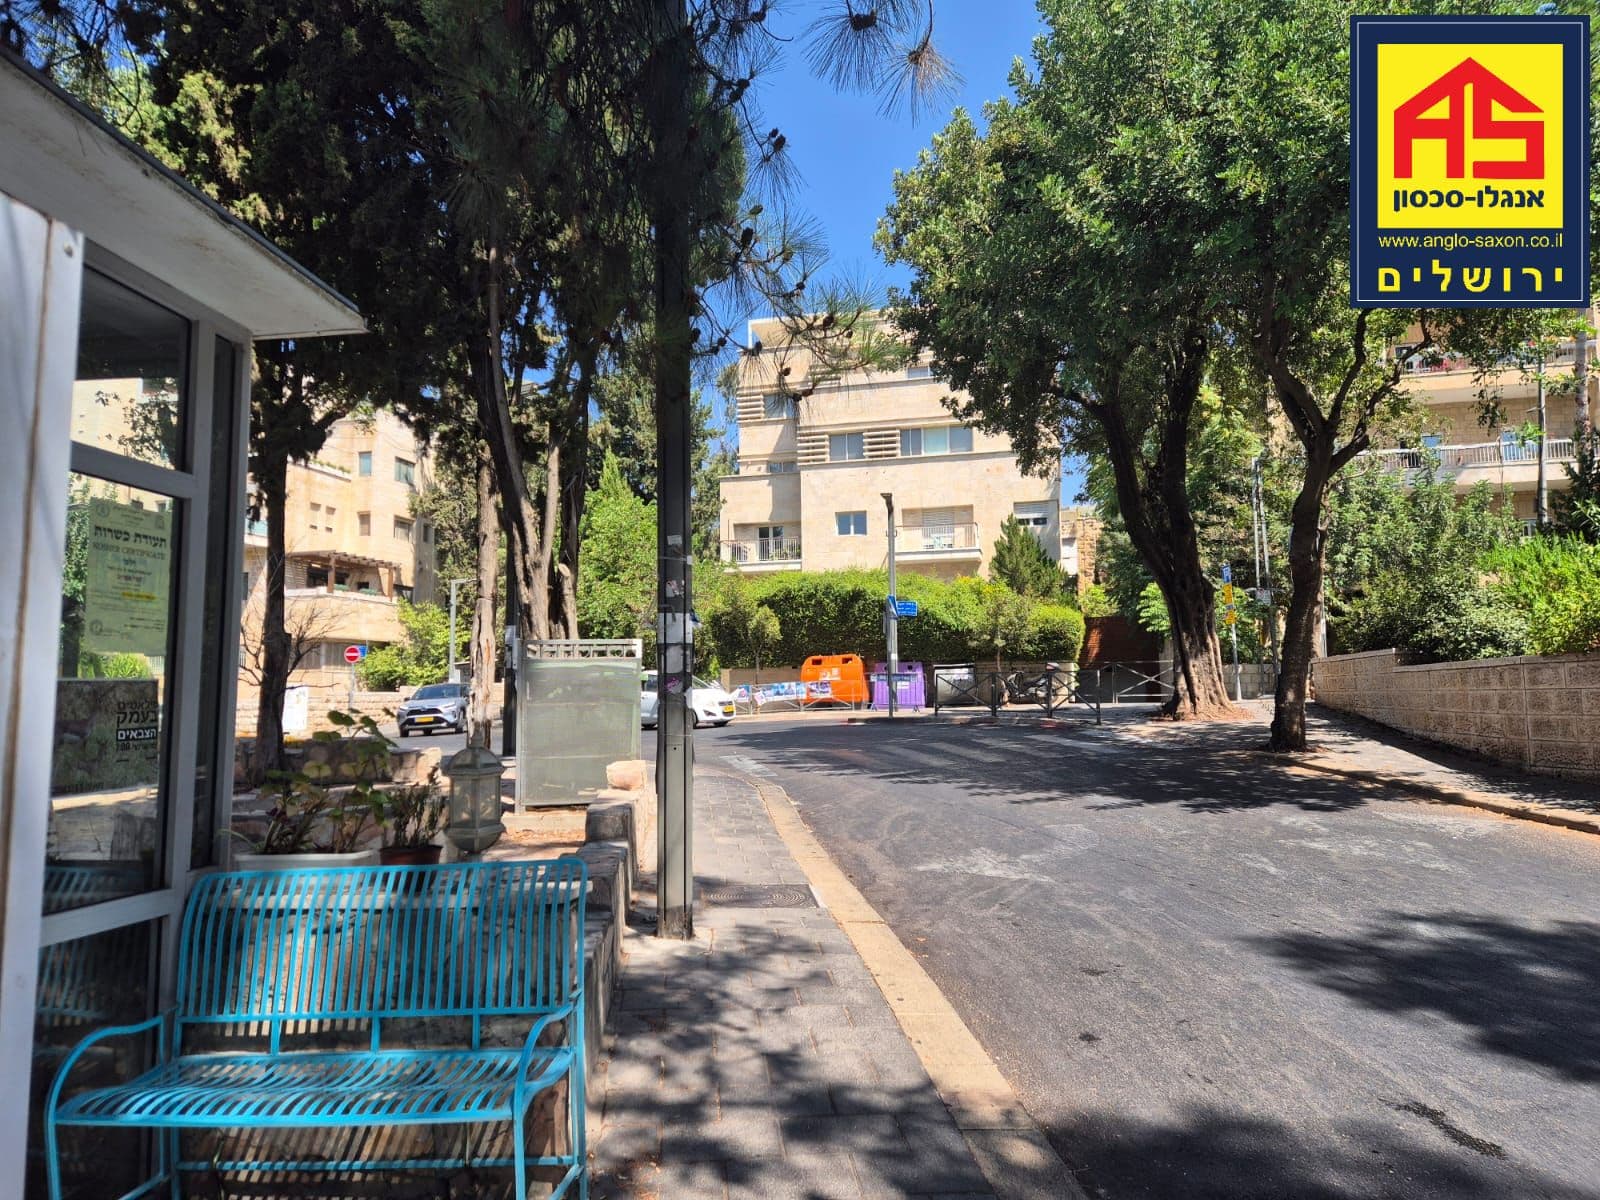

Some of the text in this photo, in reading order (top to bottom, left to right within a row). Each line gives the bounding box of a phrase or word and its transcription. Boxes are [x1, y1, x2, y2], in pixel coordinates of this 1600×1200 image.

[94, 525, 167, 548] תעודת כשרות
[116, 710, 158, 728] בעמק
[117, 728, 157, 740] הצבאים
